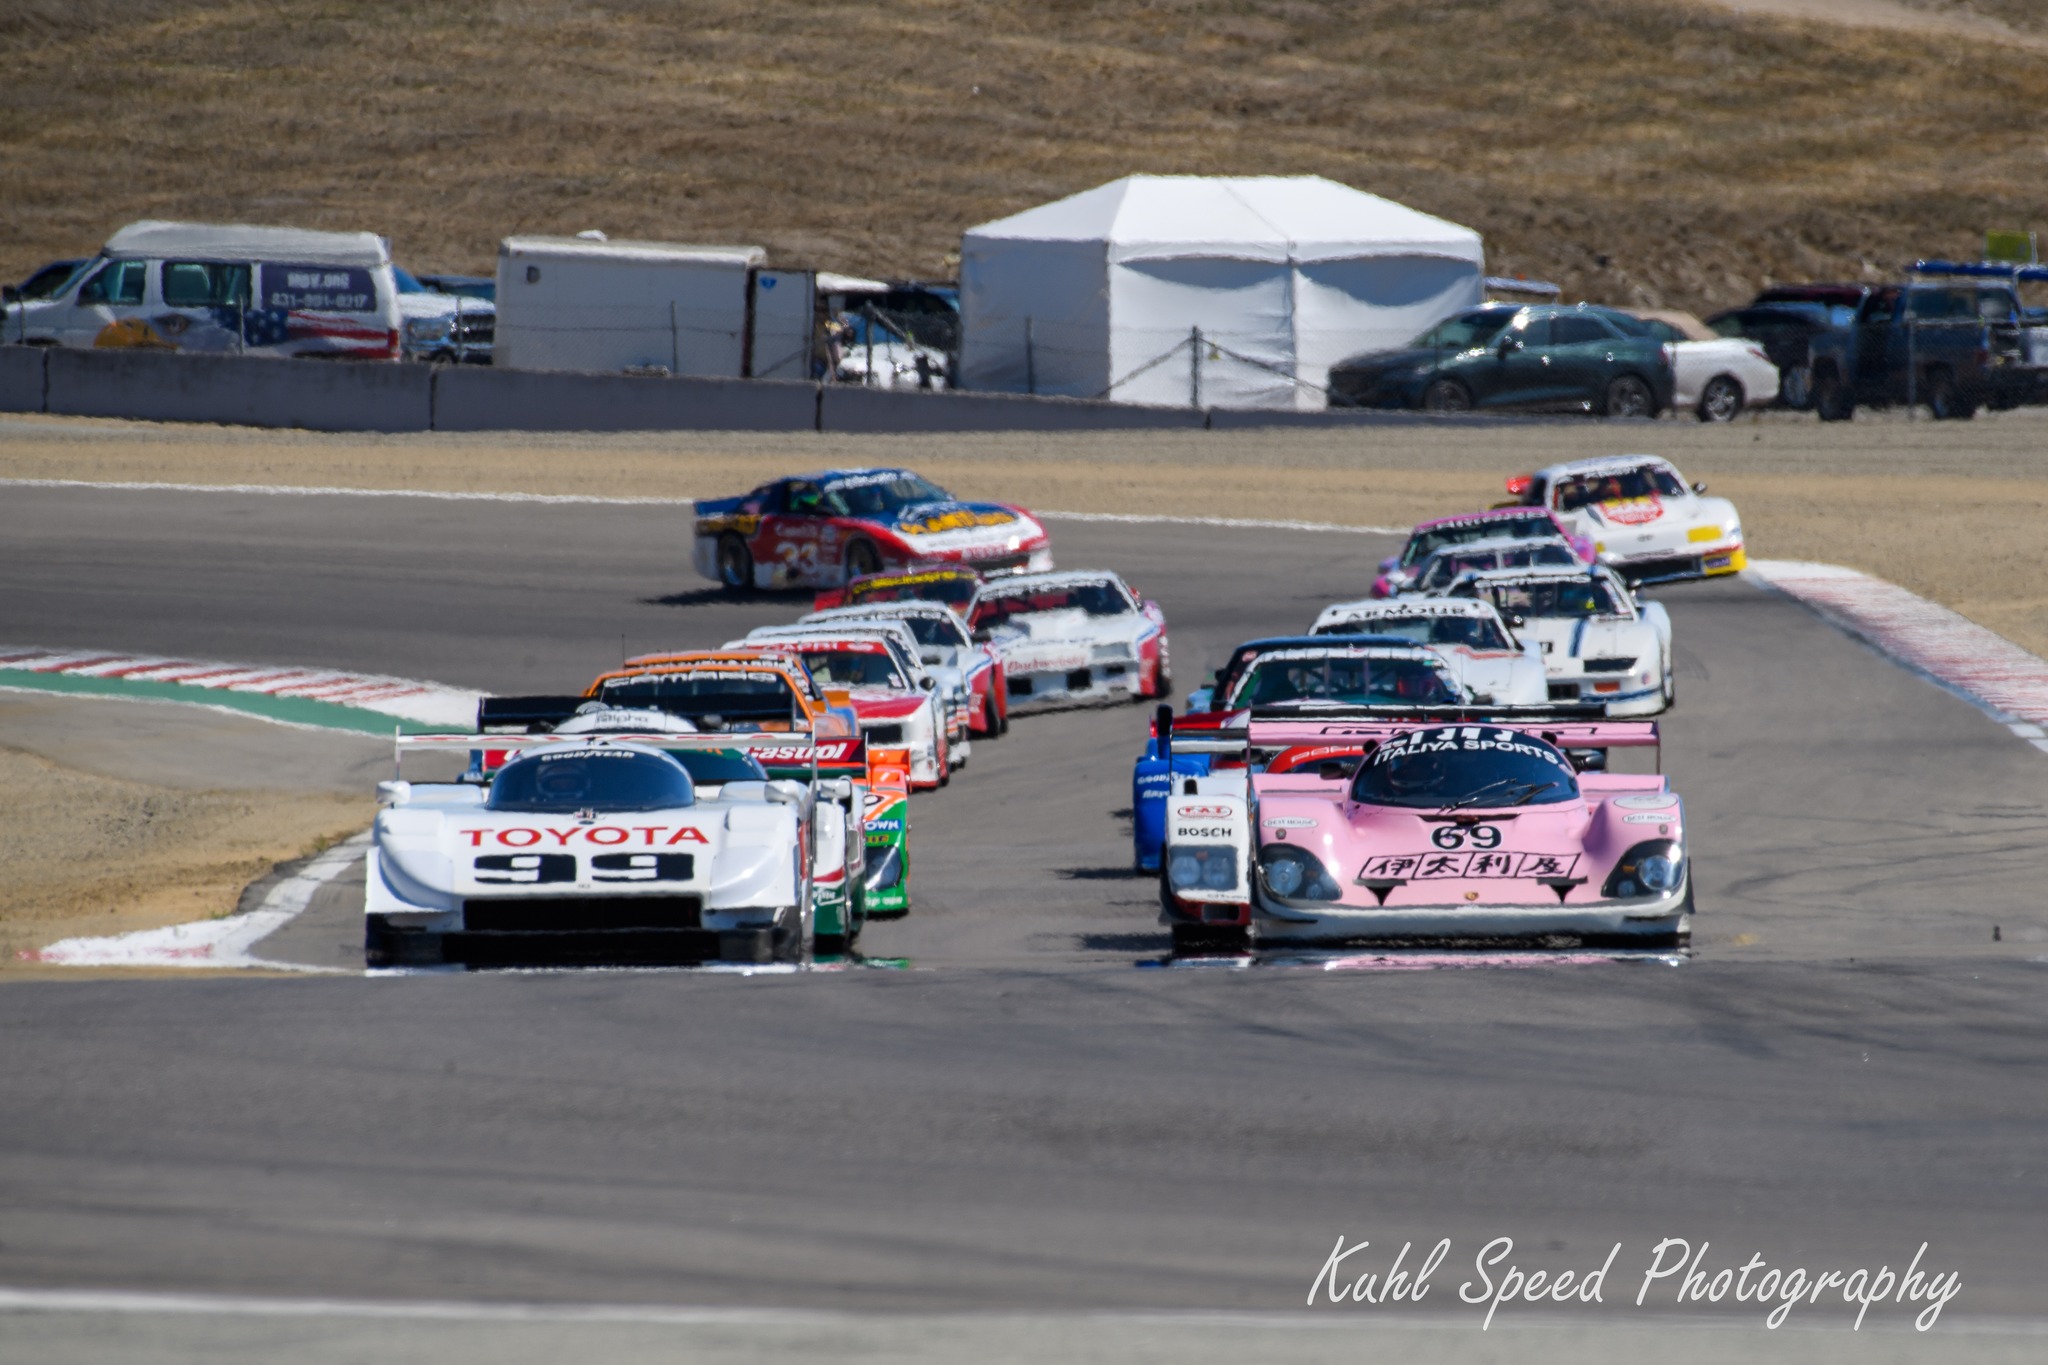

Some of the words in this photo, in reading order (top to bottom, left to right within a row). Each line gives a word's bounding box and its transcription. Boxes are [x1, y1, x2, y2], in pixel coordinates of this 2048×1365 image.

[1350, 606, 1466, 619] ARMOUR
[750, 743, 847, 760] Castrol
[1373, 740, 1459, 767] ITALIYA
[1463, 739, 1559, 765] SPORTS
[459, 826, 710, 847] TOYOTA
[1177, 827, 1232, 838] BOSCH
[1431, 825, 1503, 850] 69
[473, 852, 694, 885] 99
